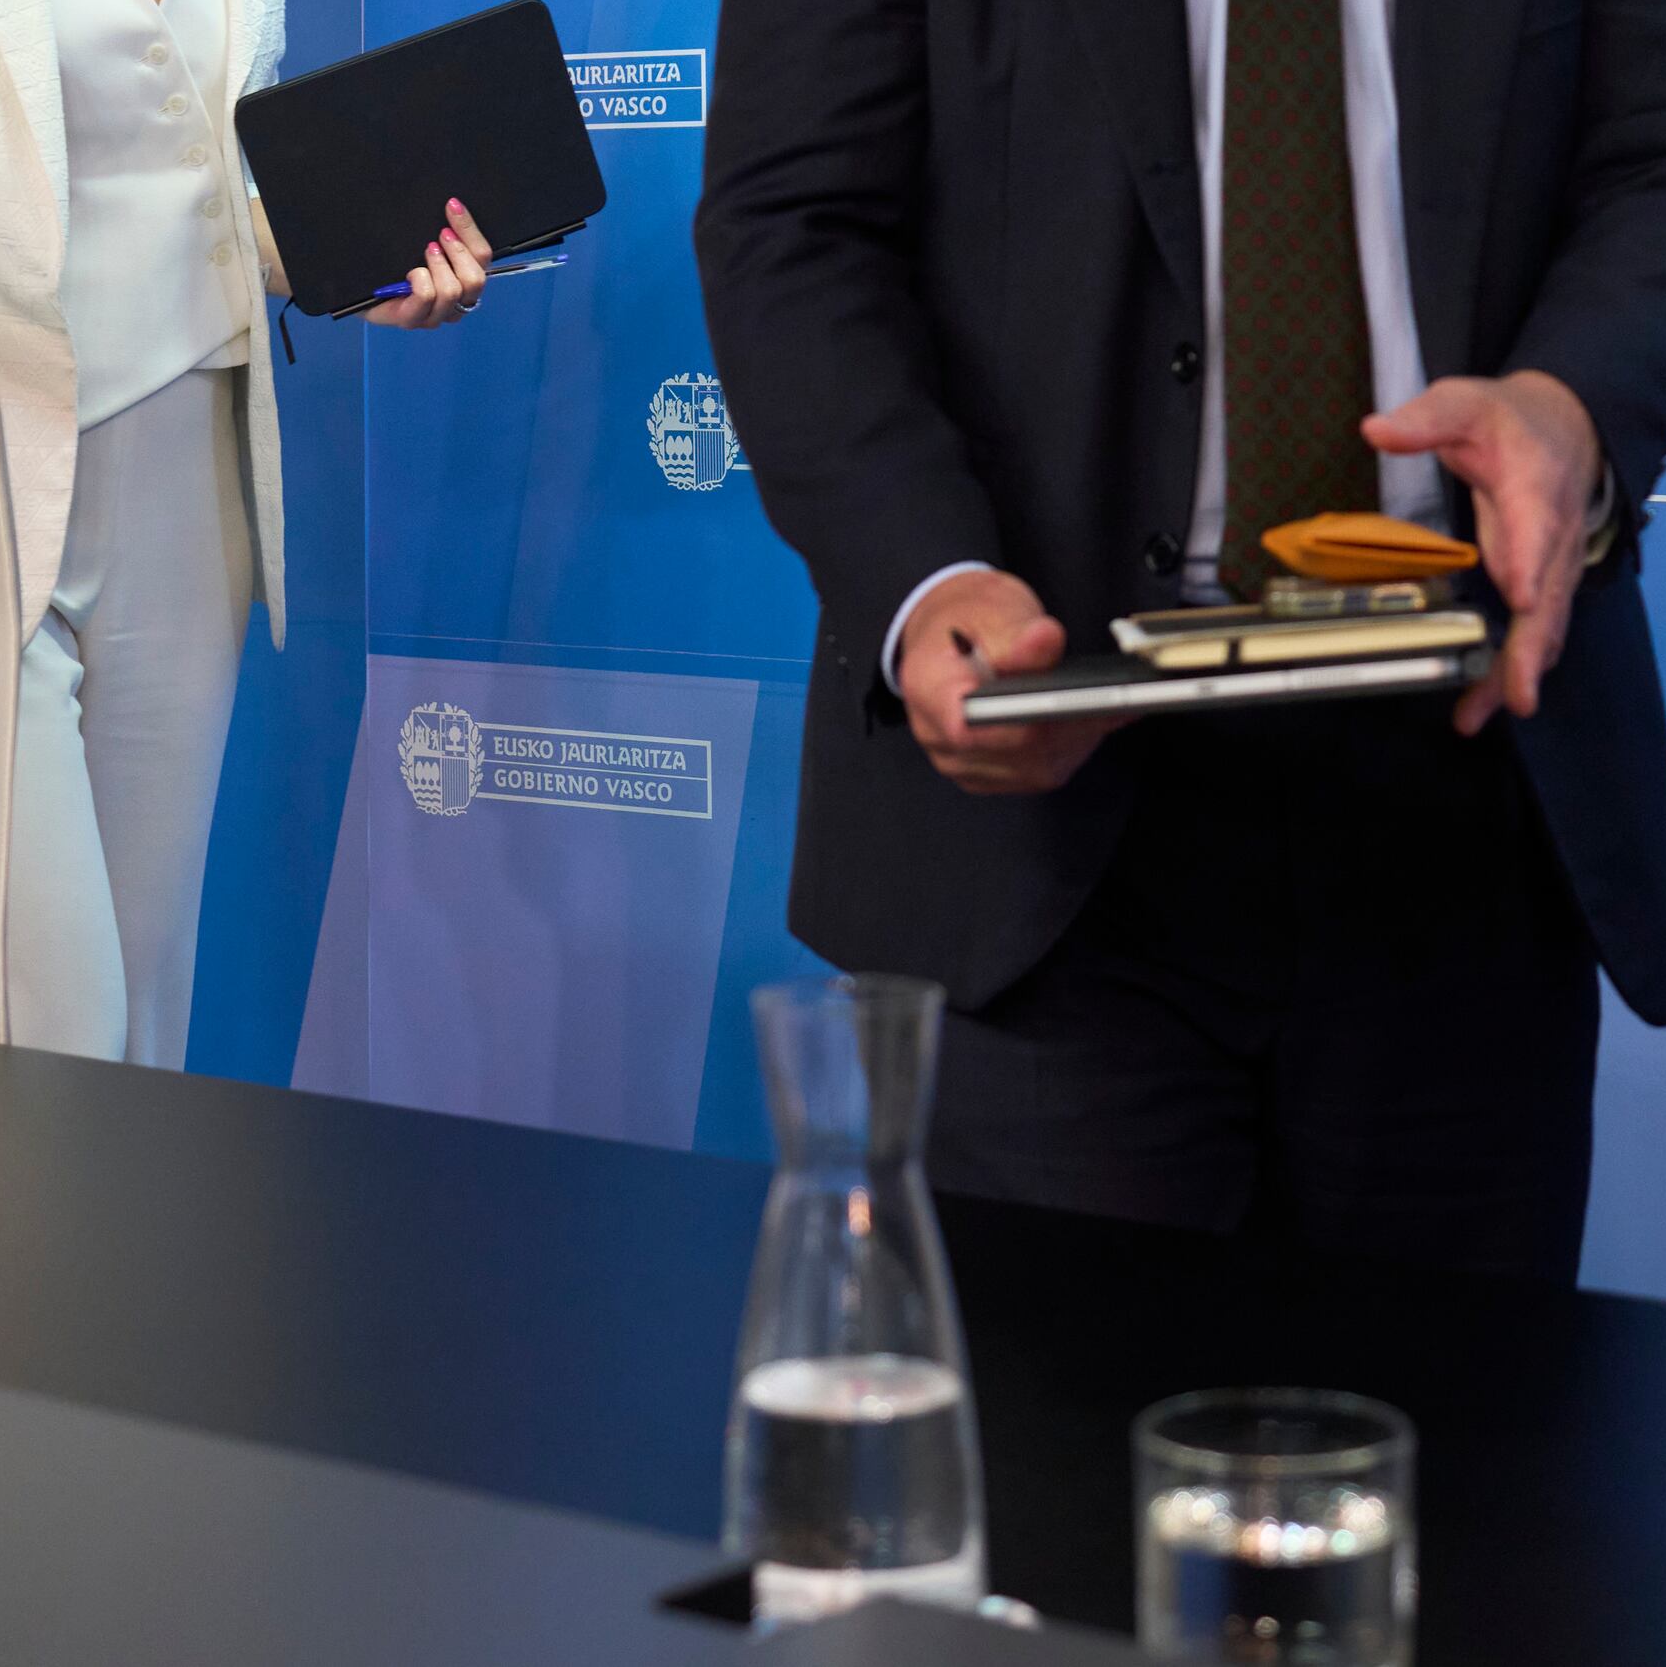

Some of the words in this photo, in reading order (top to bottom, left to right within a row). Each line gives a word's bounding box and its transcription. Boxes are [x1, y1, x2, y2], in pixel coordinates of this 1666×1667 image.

[566, 63, 681, 85] AURLARITZA
[599, 95, 667, 116] VASCO
[493, 736, 554, 759] EUSKO
[560, 741, 687, 770] JAURLARITZA
[494, 769, 599, 796] GOBIERNO
[605, 778, 673, 802] VASCO
